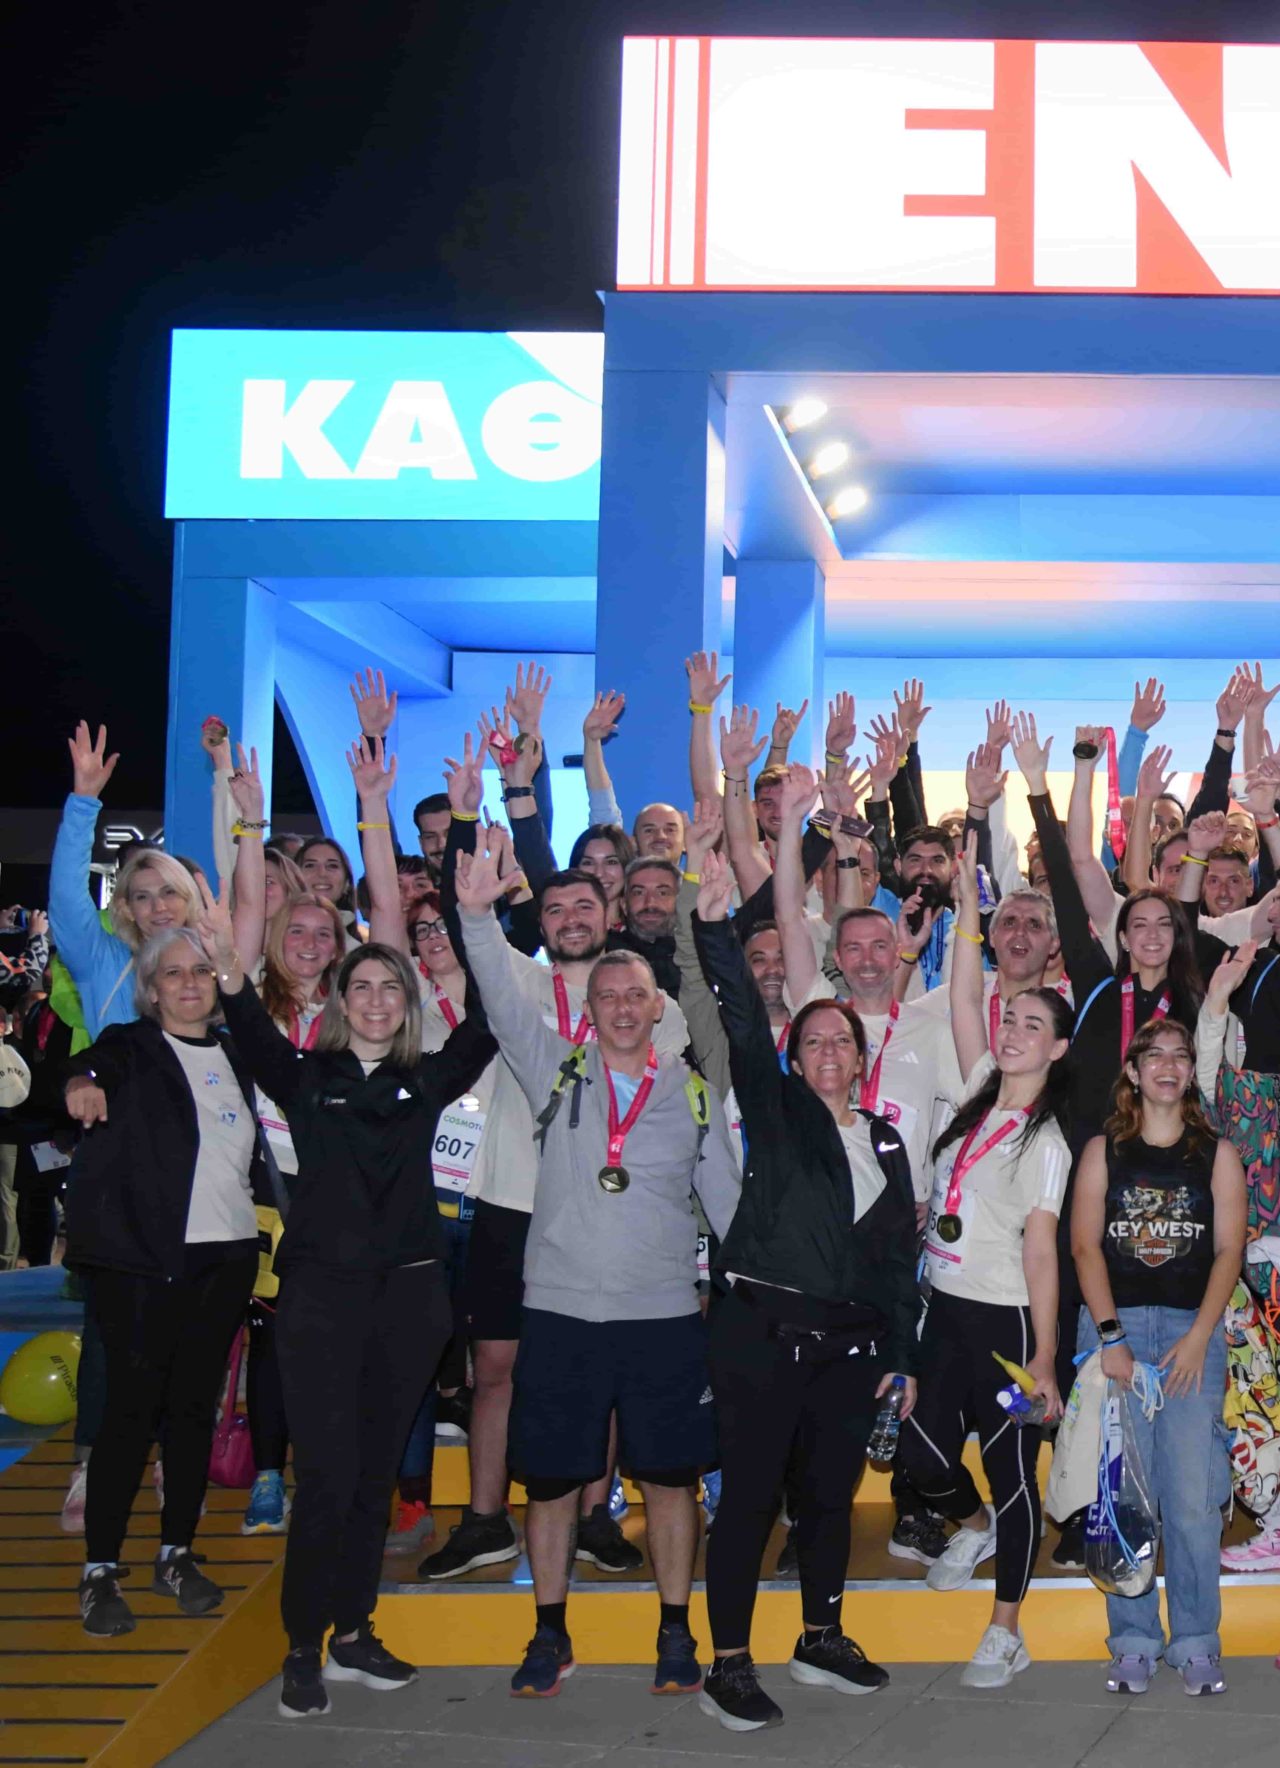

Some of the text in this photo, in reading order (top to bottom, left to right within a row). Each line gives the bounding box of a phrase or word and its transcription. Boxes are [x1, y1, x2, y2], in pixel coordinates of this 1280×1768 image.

[240, 379, 603, 482] ΚΑΘ
[1108, 1222, 1205, 1240] KEY WEST
